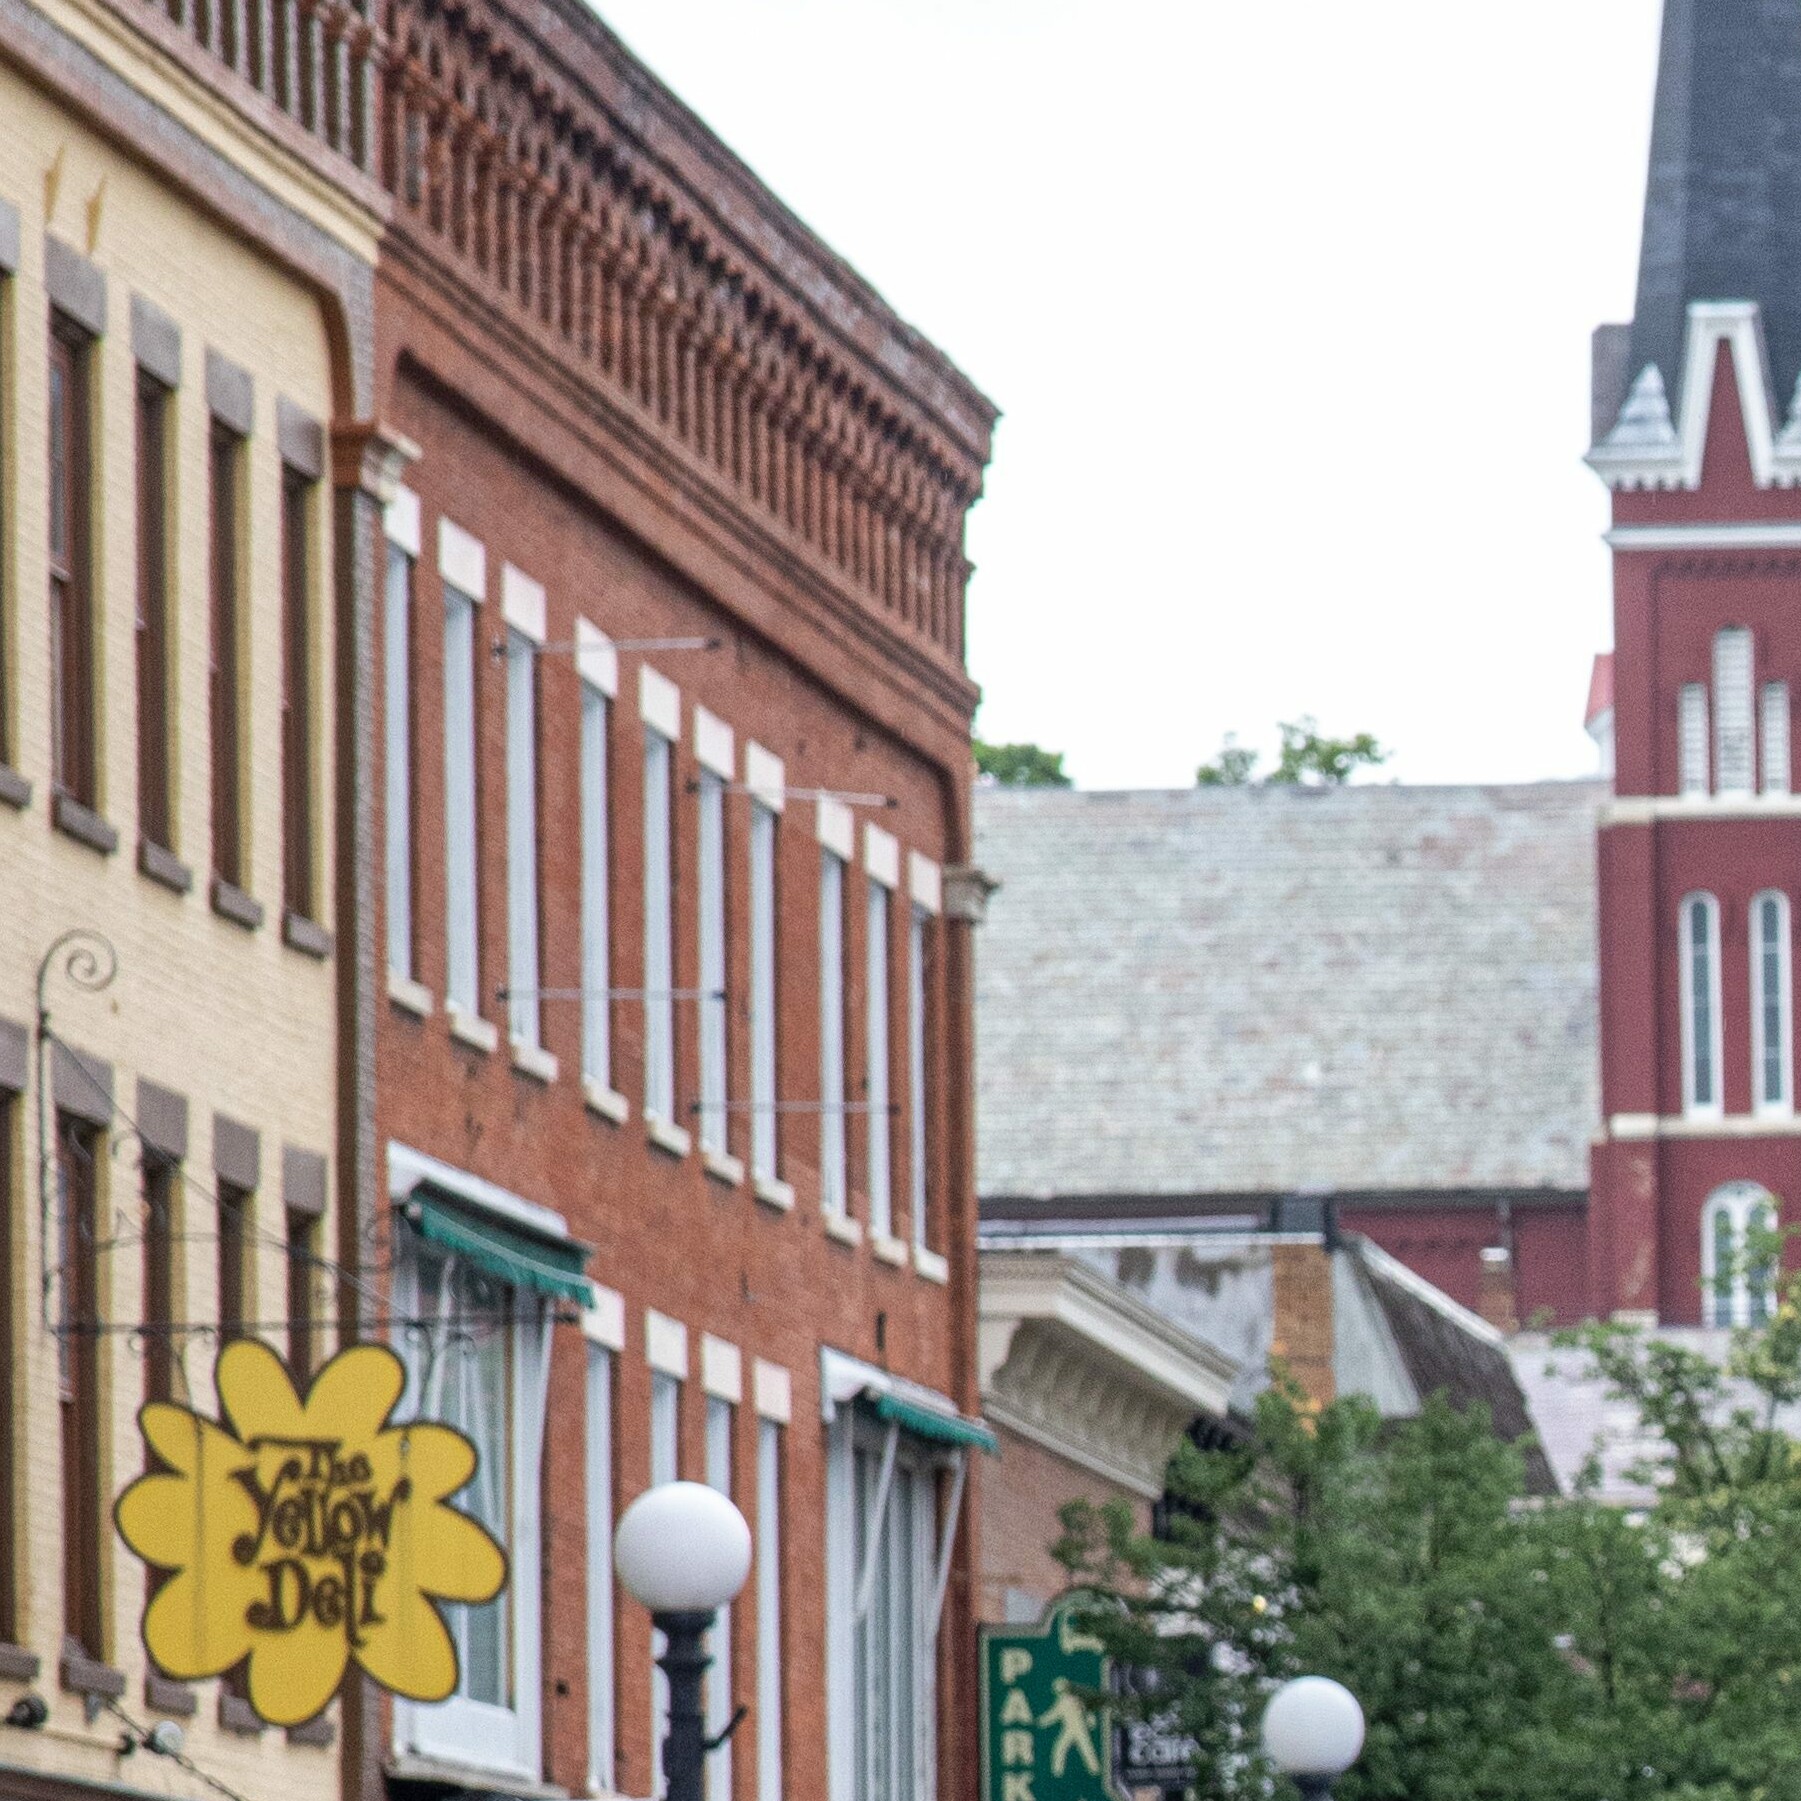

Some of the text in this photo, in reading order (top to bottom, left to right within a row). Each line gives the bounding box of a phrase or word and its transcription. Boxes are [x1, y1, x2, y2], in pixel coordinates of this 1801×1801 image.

[247, 1435, 372, 1485] The
[229, 1459, 412, 1567] Yellow
[246, 1549, 386, 1648] Deli
